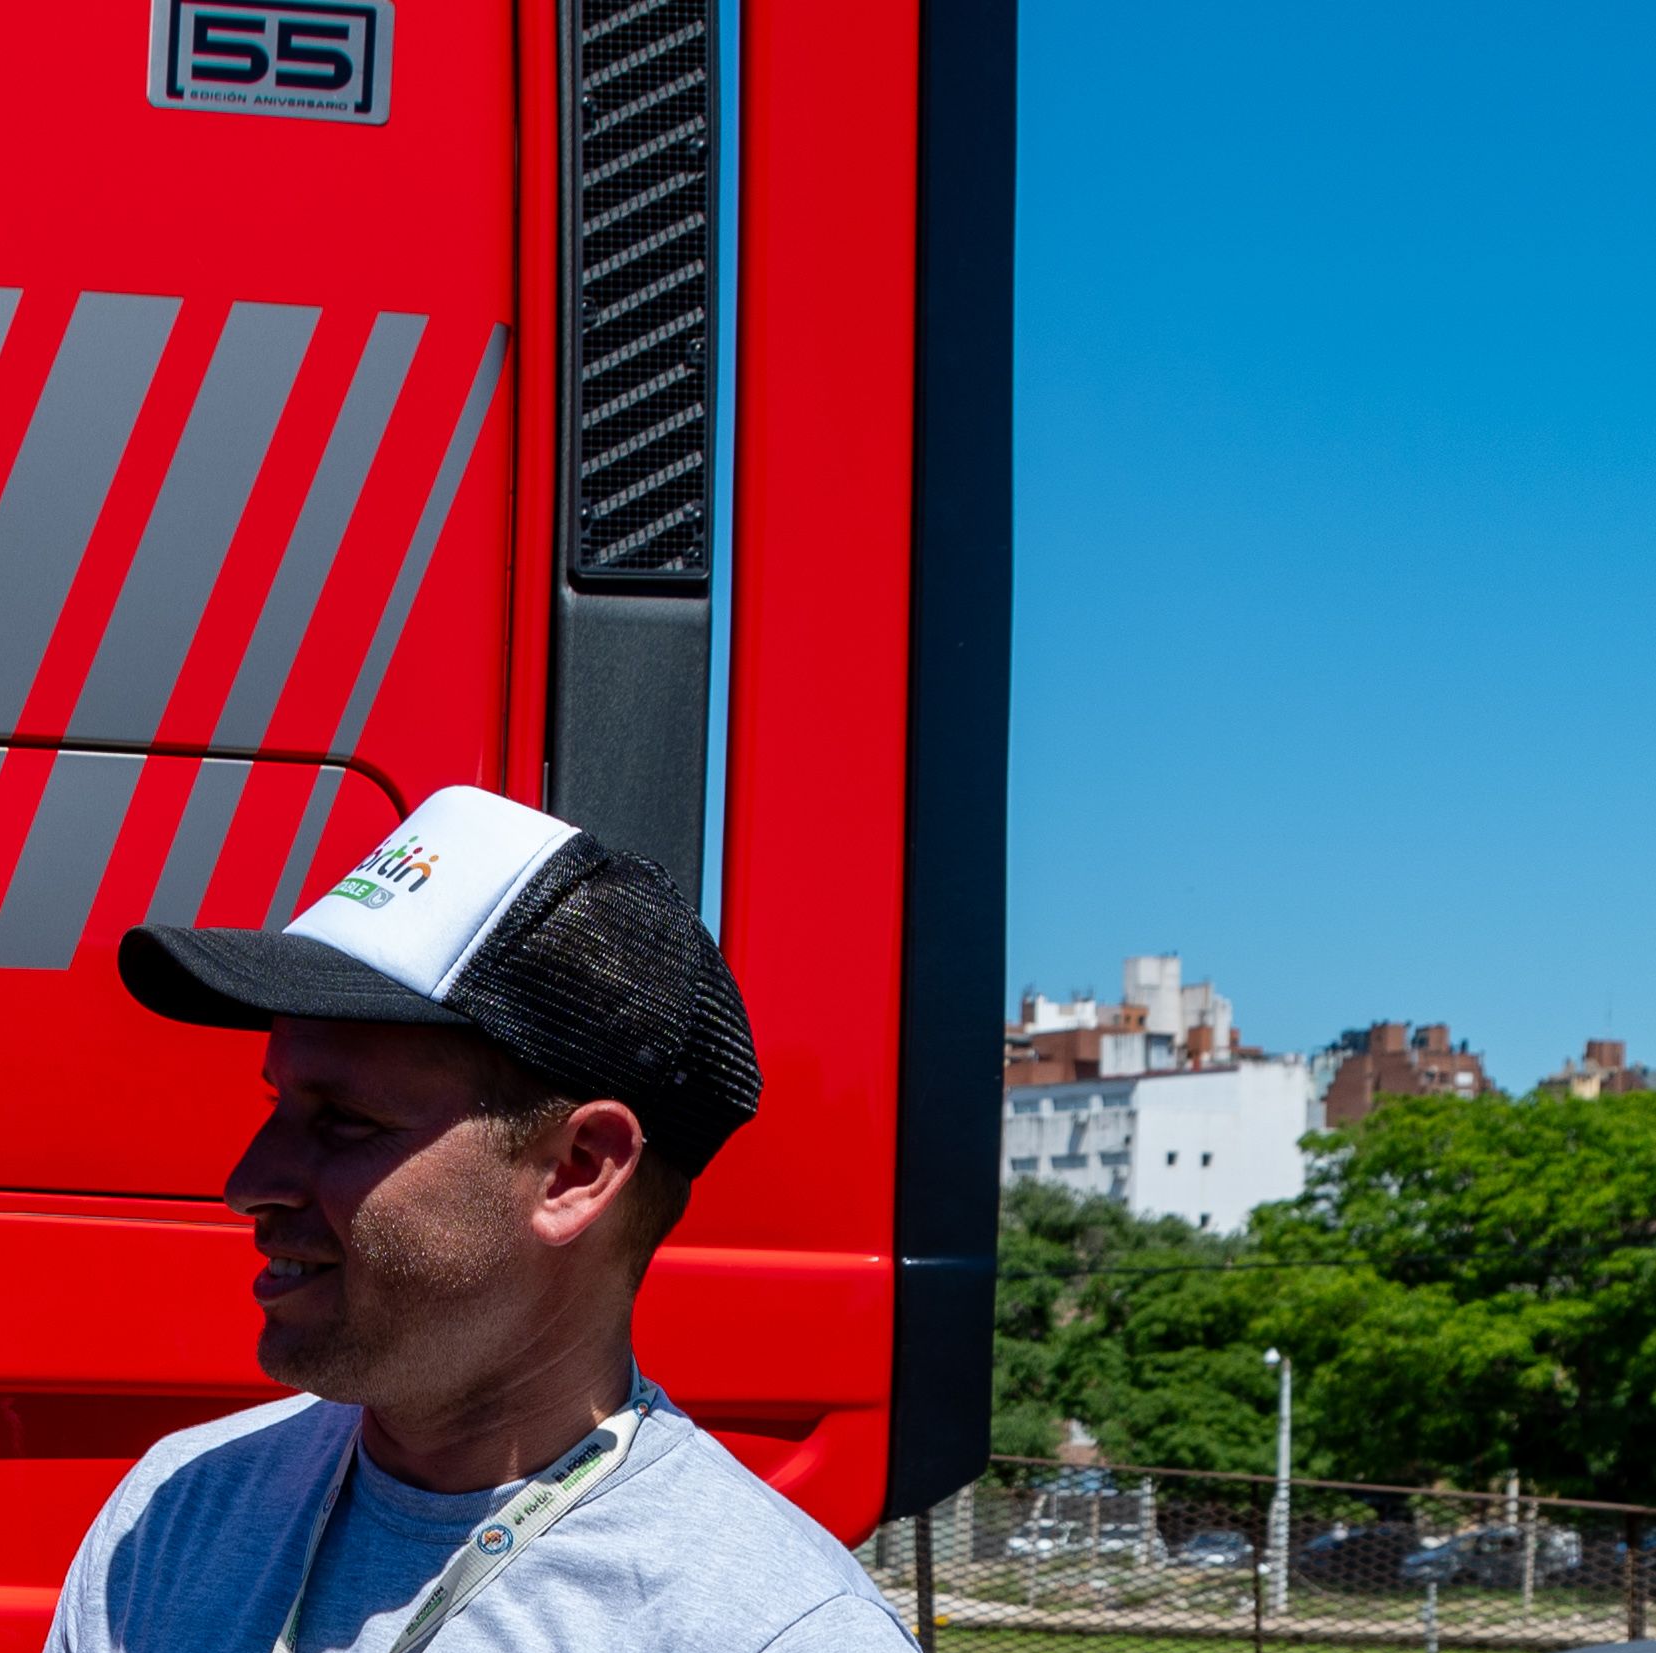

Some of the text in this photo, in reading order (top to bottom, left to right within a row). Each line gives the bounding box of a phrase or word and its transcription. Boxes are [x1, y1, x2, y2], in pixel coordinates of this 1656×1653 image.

[191, 11, 353, 90] 55
[190, 91, 348, 111] EDICIÓN ANIVERSARIO
